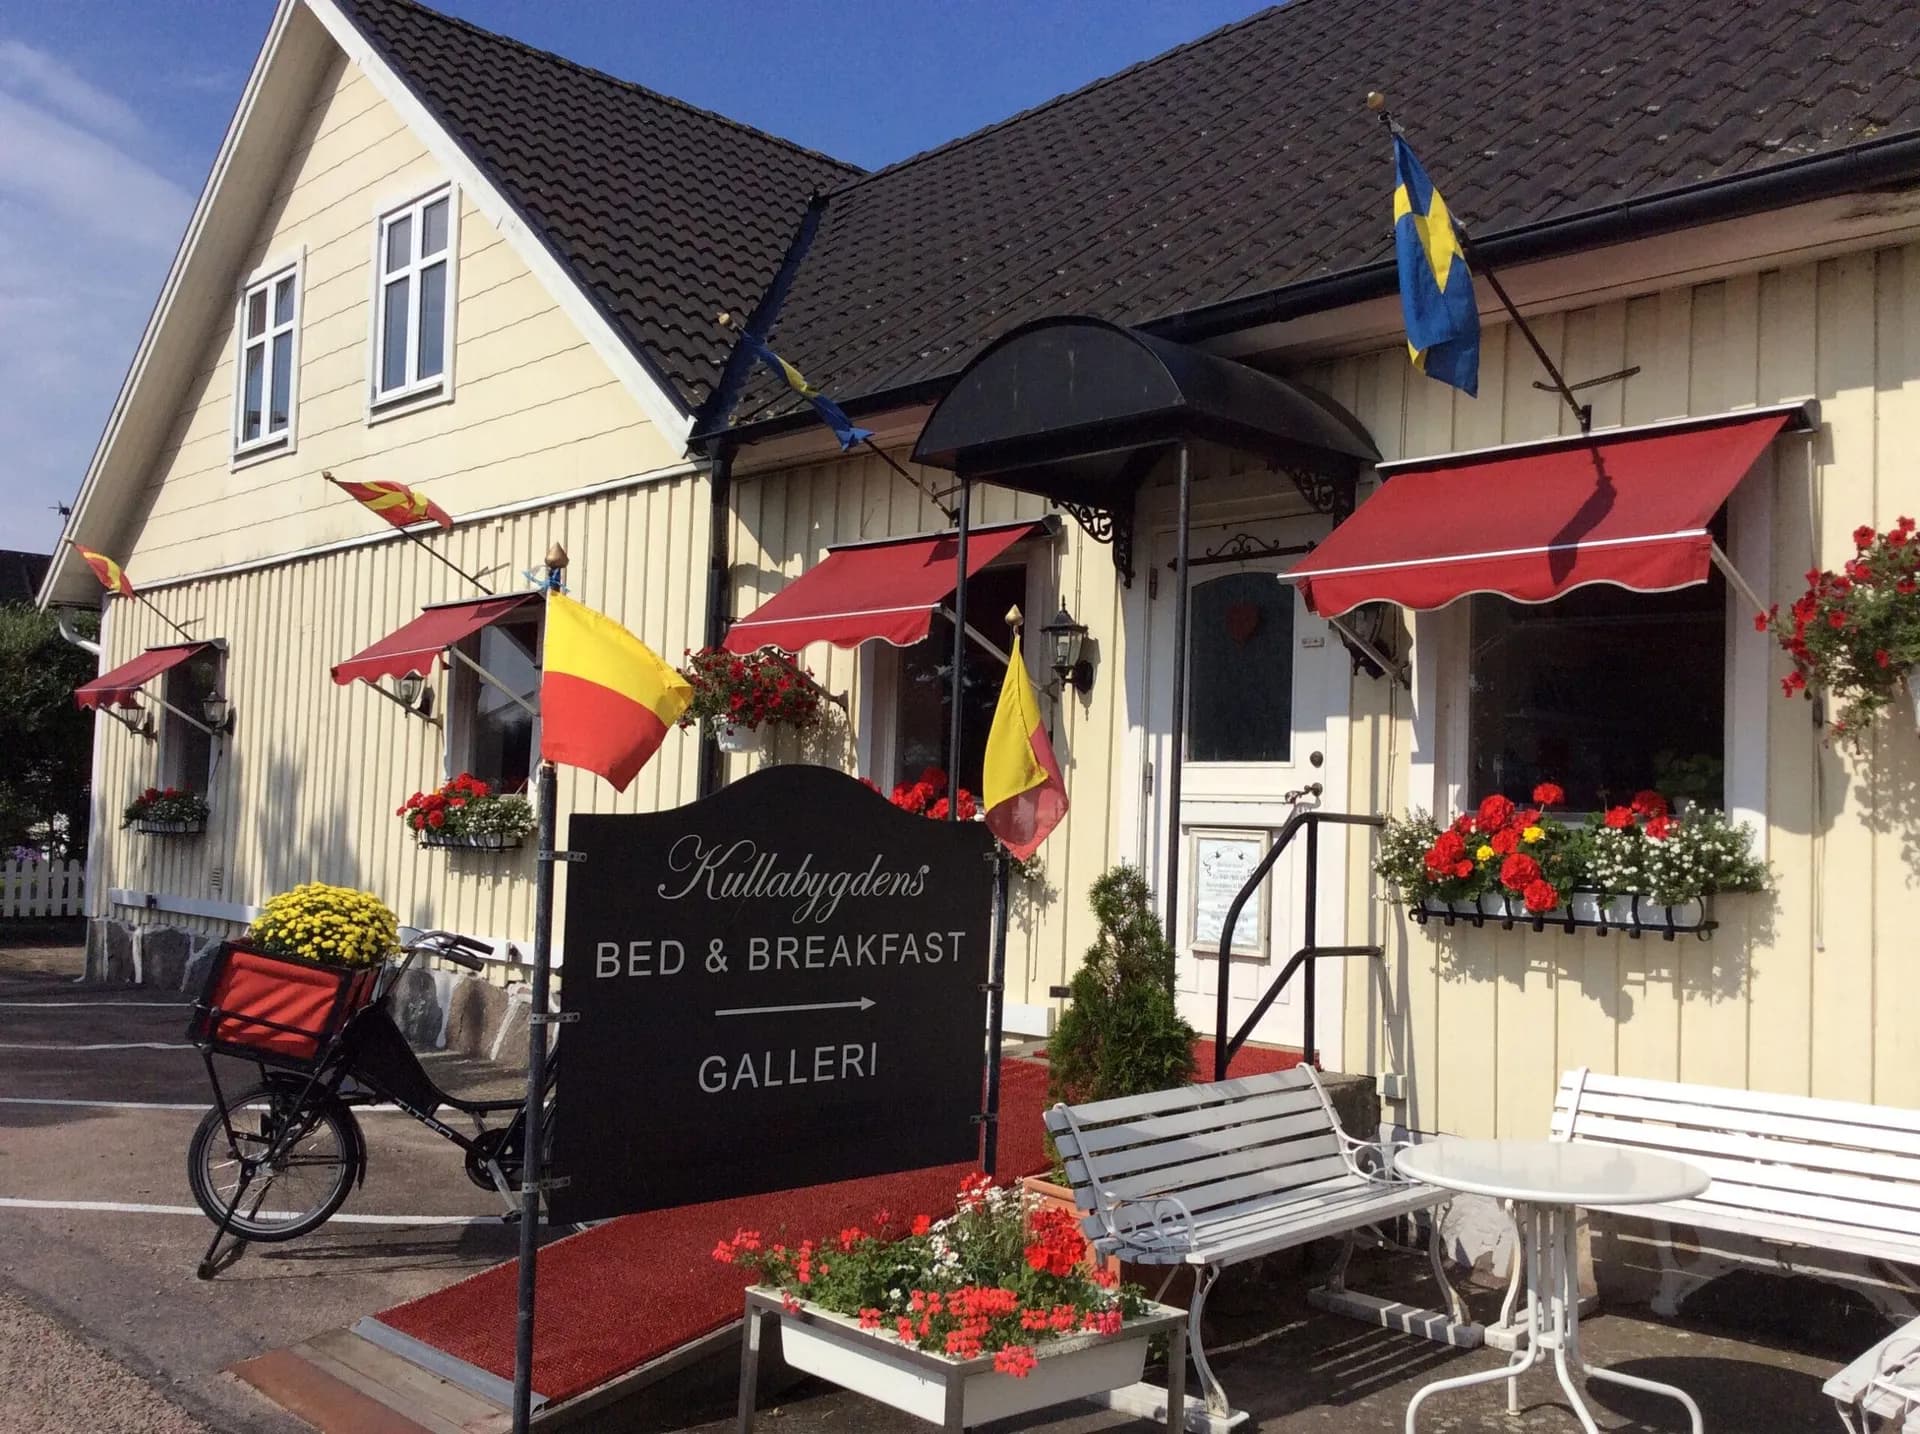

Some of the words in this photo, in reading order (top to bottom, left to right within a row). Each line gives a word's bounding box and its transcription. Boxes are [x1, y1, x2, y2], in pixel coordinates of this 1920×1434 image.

[657, 834, 930, 924] Kullabygdens
[596, 940, 685, 978] BED
[705, 938, 729, 973] &
[749, 931, 966, 971] BREAKFAST
[698, 1042, 877, 1093] GALLERI
